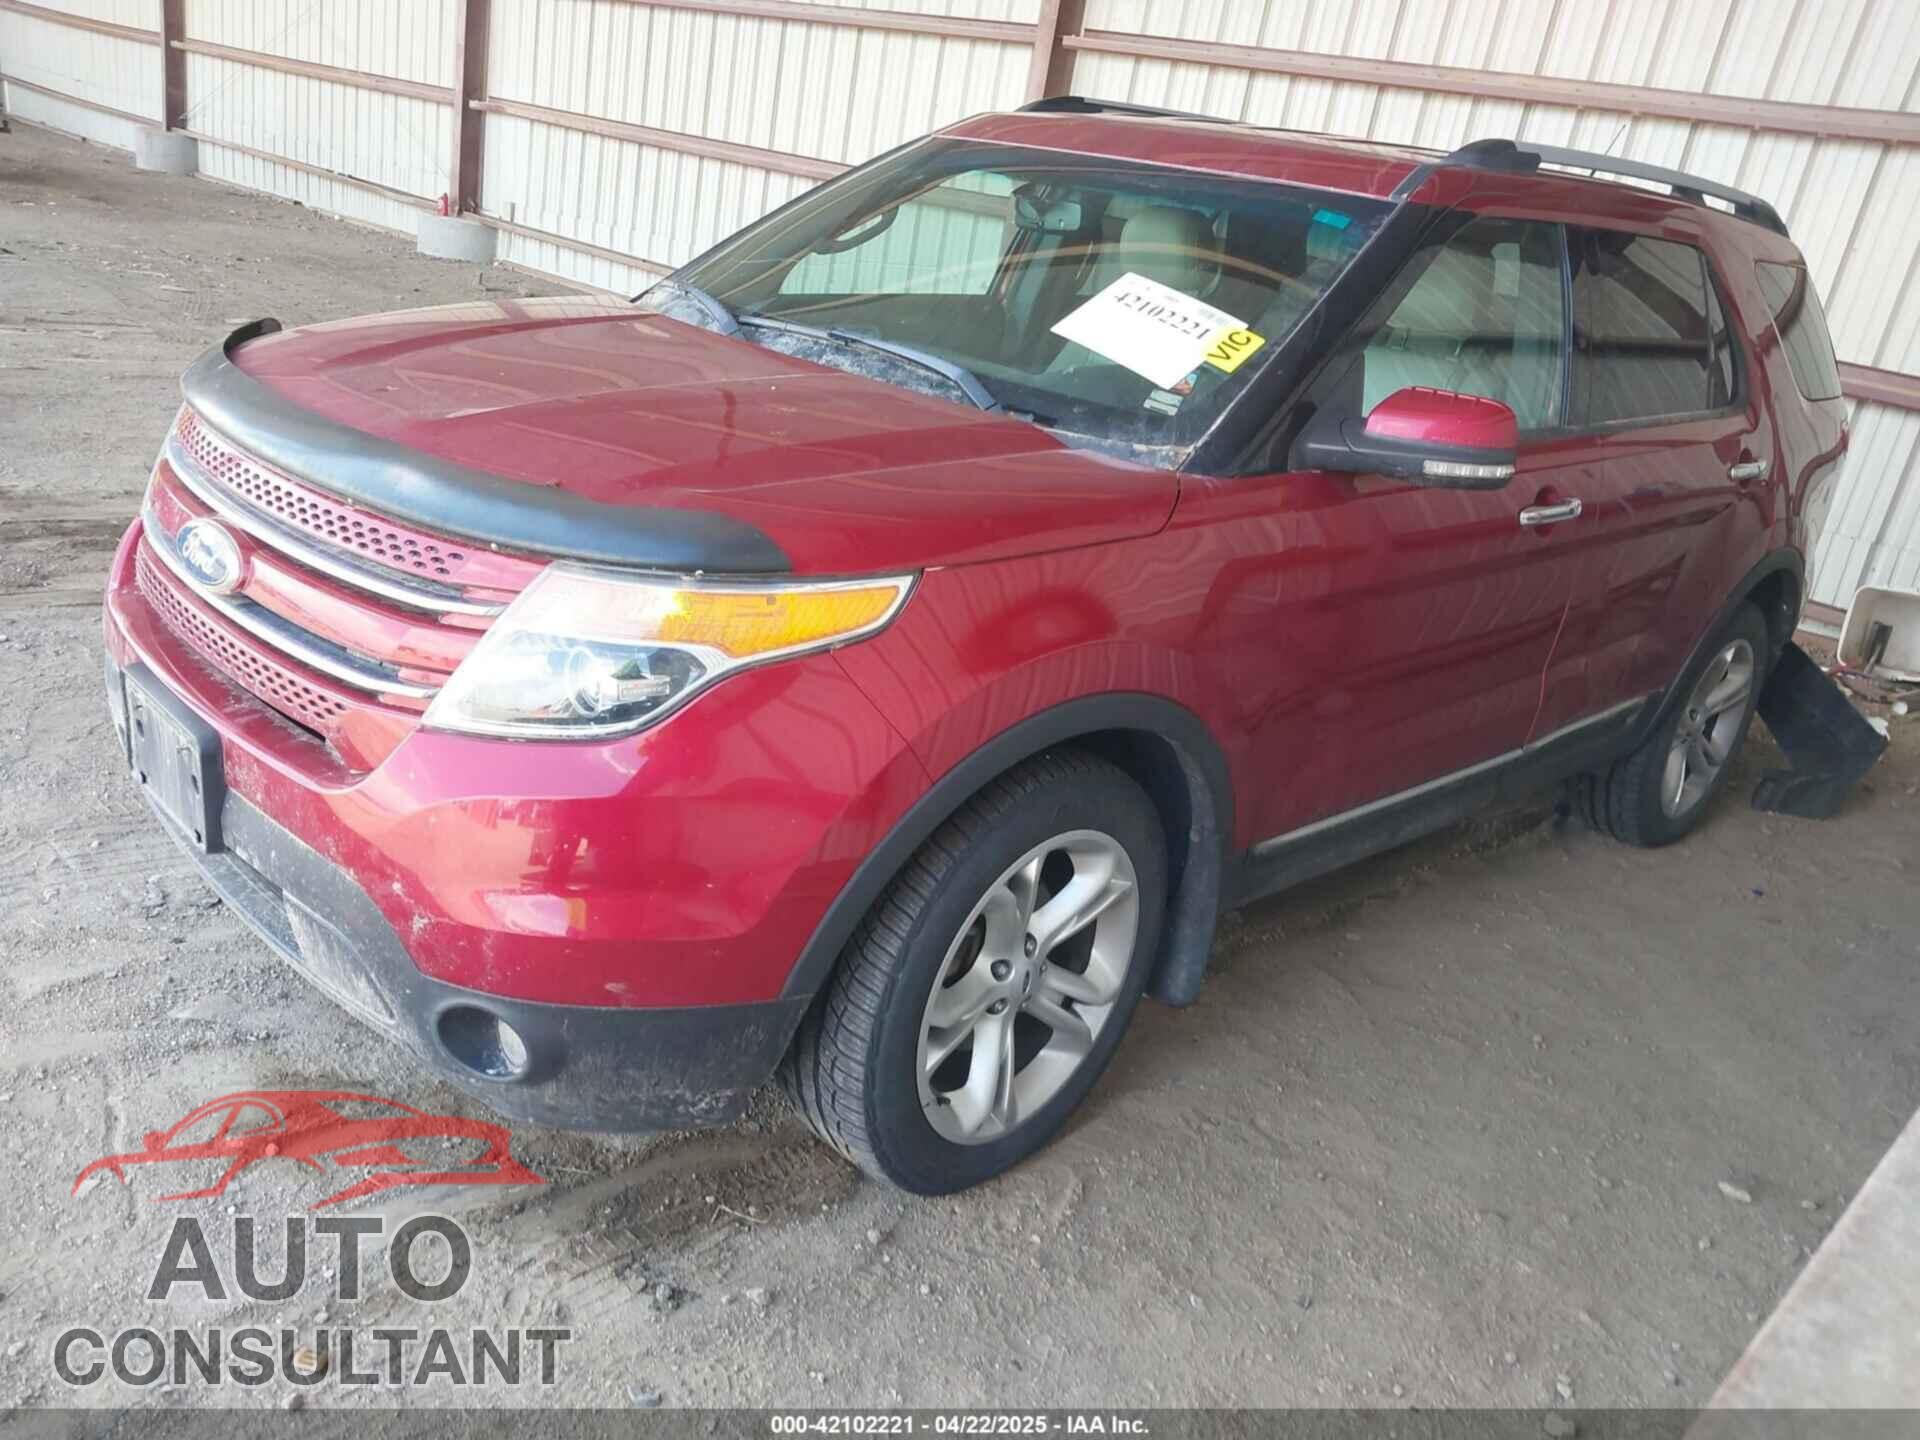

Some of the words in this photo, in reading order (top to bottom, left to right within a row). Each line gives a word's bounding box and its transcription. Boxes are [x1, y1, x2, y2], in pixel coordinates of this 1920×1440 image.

[1113, 291, 1212, 340] 42102221
[1207, 330, 1252, 361] VIC
[182, 529, 218, 575] Ford
